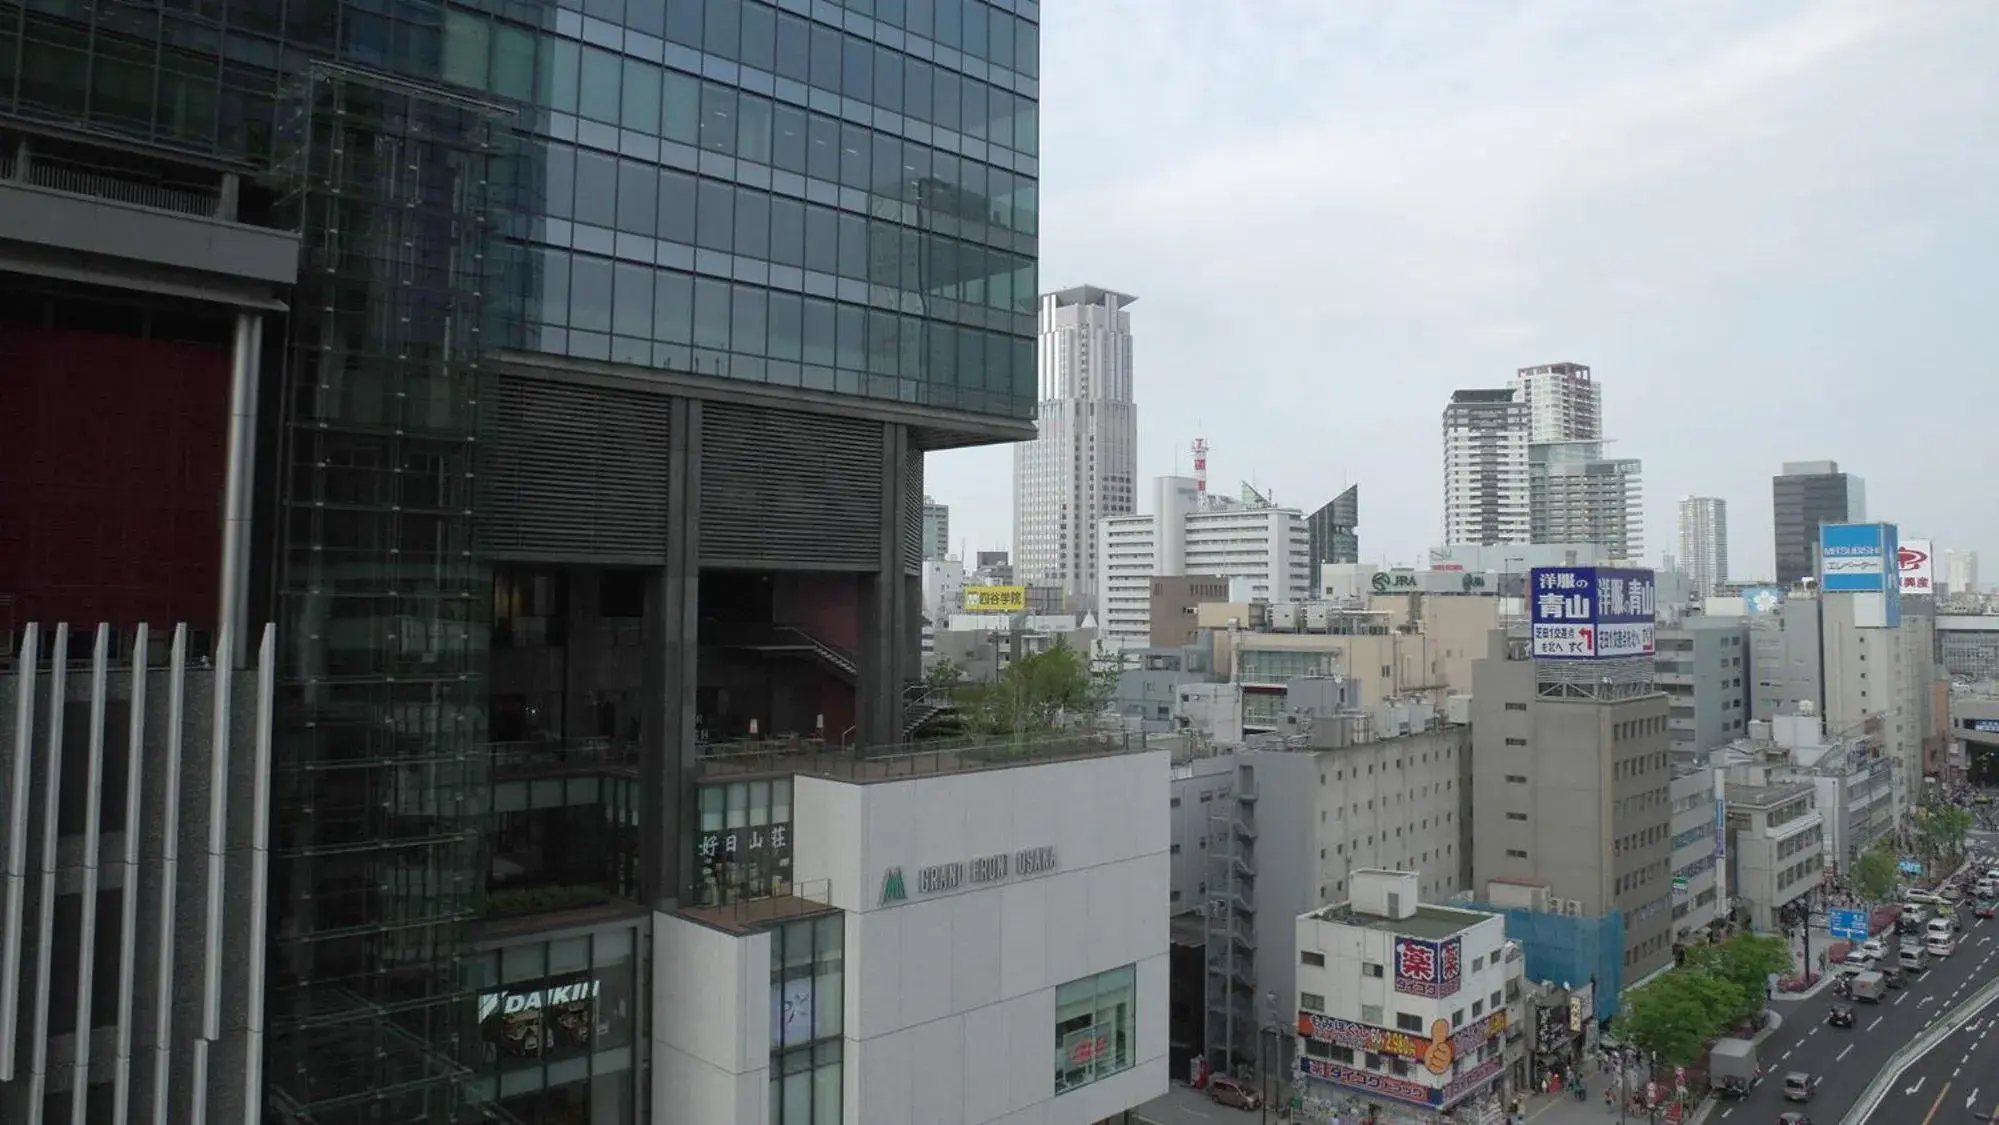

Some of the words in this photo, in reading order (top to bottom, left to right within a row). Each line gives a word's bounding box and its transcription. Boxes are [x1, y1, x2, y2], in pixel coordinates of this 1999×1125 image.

[1394, 575, 1417, 587] JRA
[1540, 573, 1588, 589] 洋服の
[980, 591, 1021, 606] 四谷学院
[1538, 593, 1590, 618] 青山
[699, 825, 786, 856] 好日山荘
[1400, 938, 1435, 980] 薬
[504, 980, 599, 1014] DAIKIN
